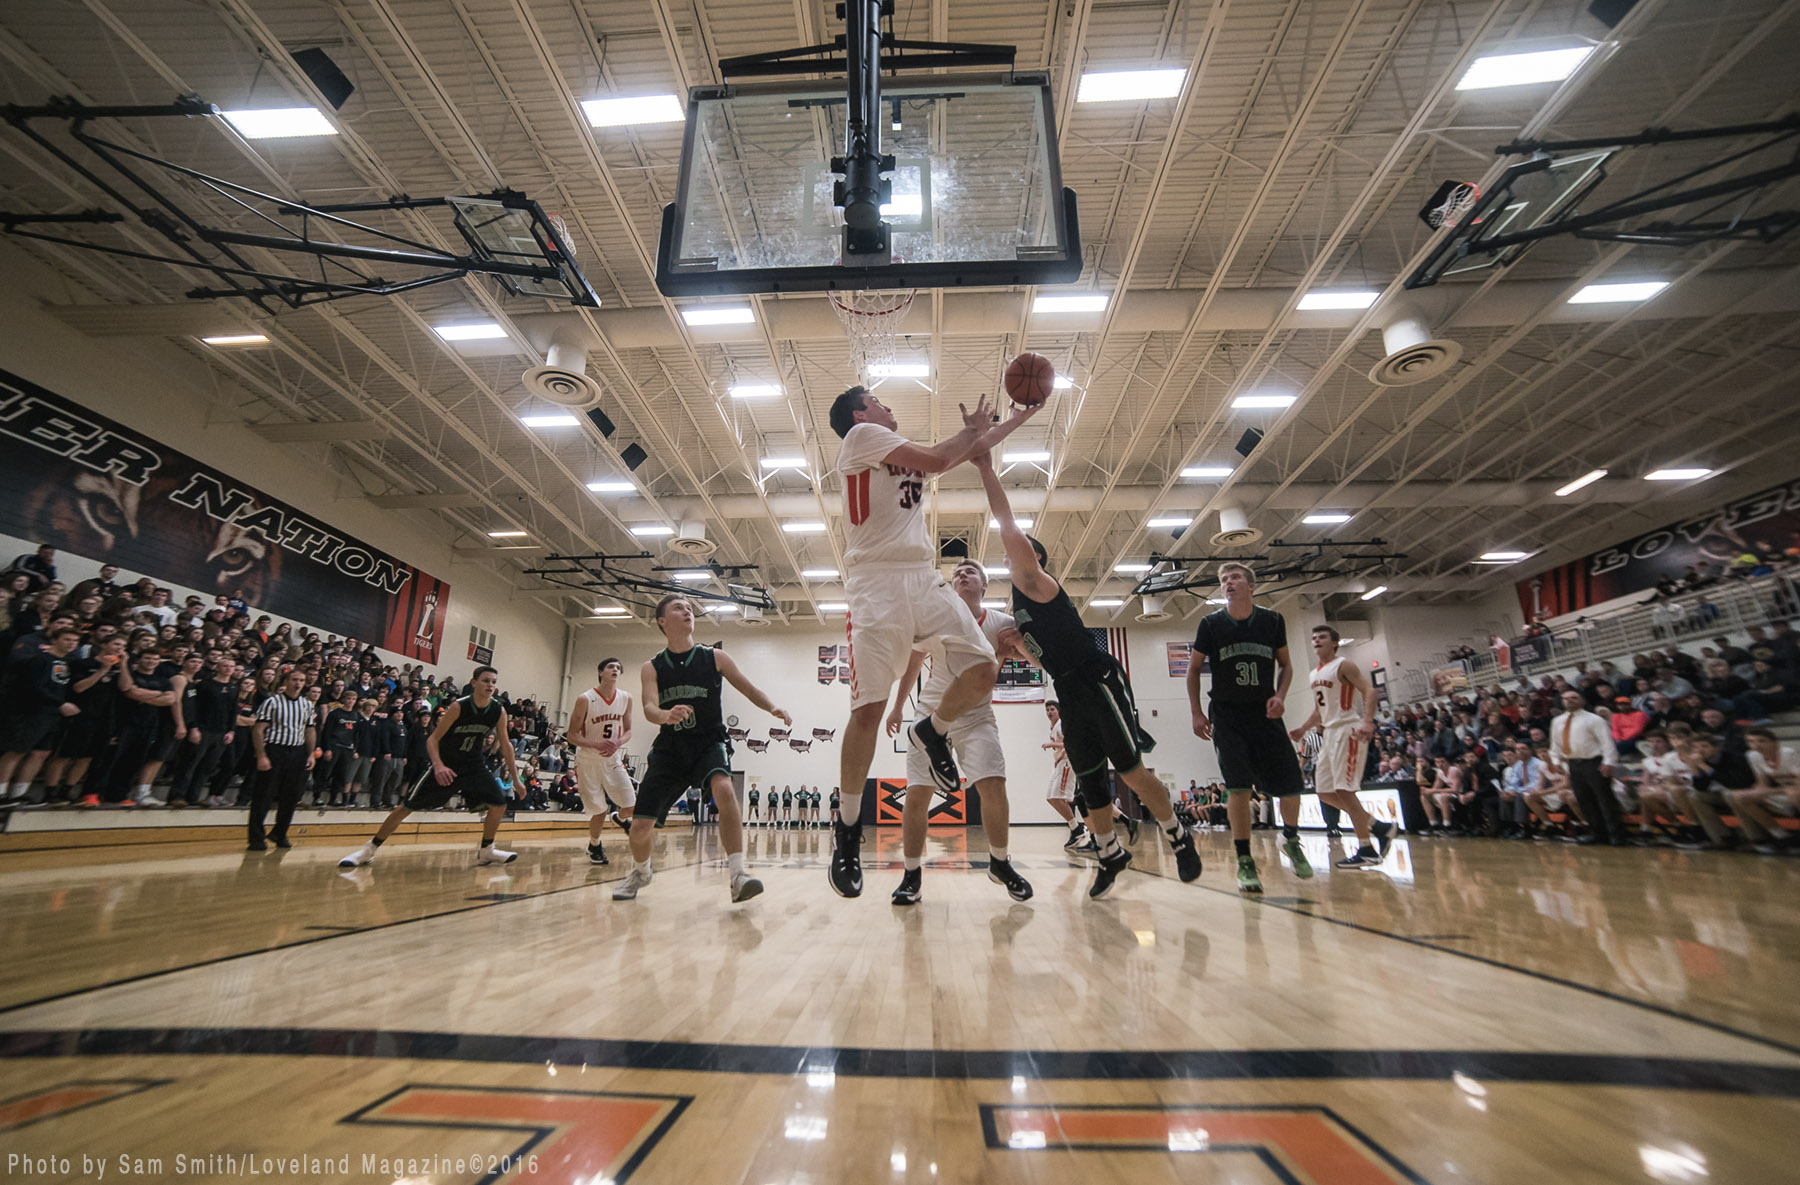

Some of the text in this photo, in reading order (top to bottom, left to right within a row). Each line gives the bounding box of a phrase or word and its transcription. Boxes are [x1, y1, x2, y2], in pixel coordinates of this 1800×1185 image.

[168, 472, 411, 595] NATION
[1235, 661, 1259, 686] 31
[1316, 690, 1326, 706] 2
[674, 704, 697, 731] 0
[603, 723, 613, 739] 5
[459, 735, 477, 752] 11
